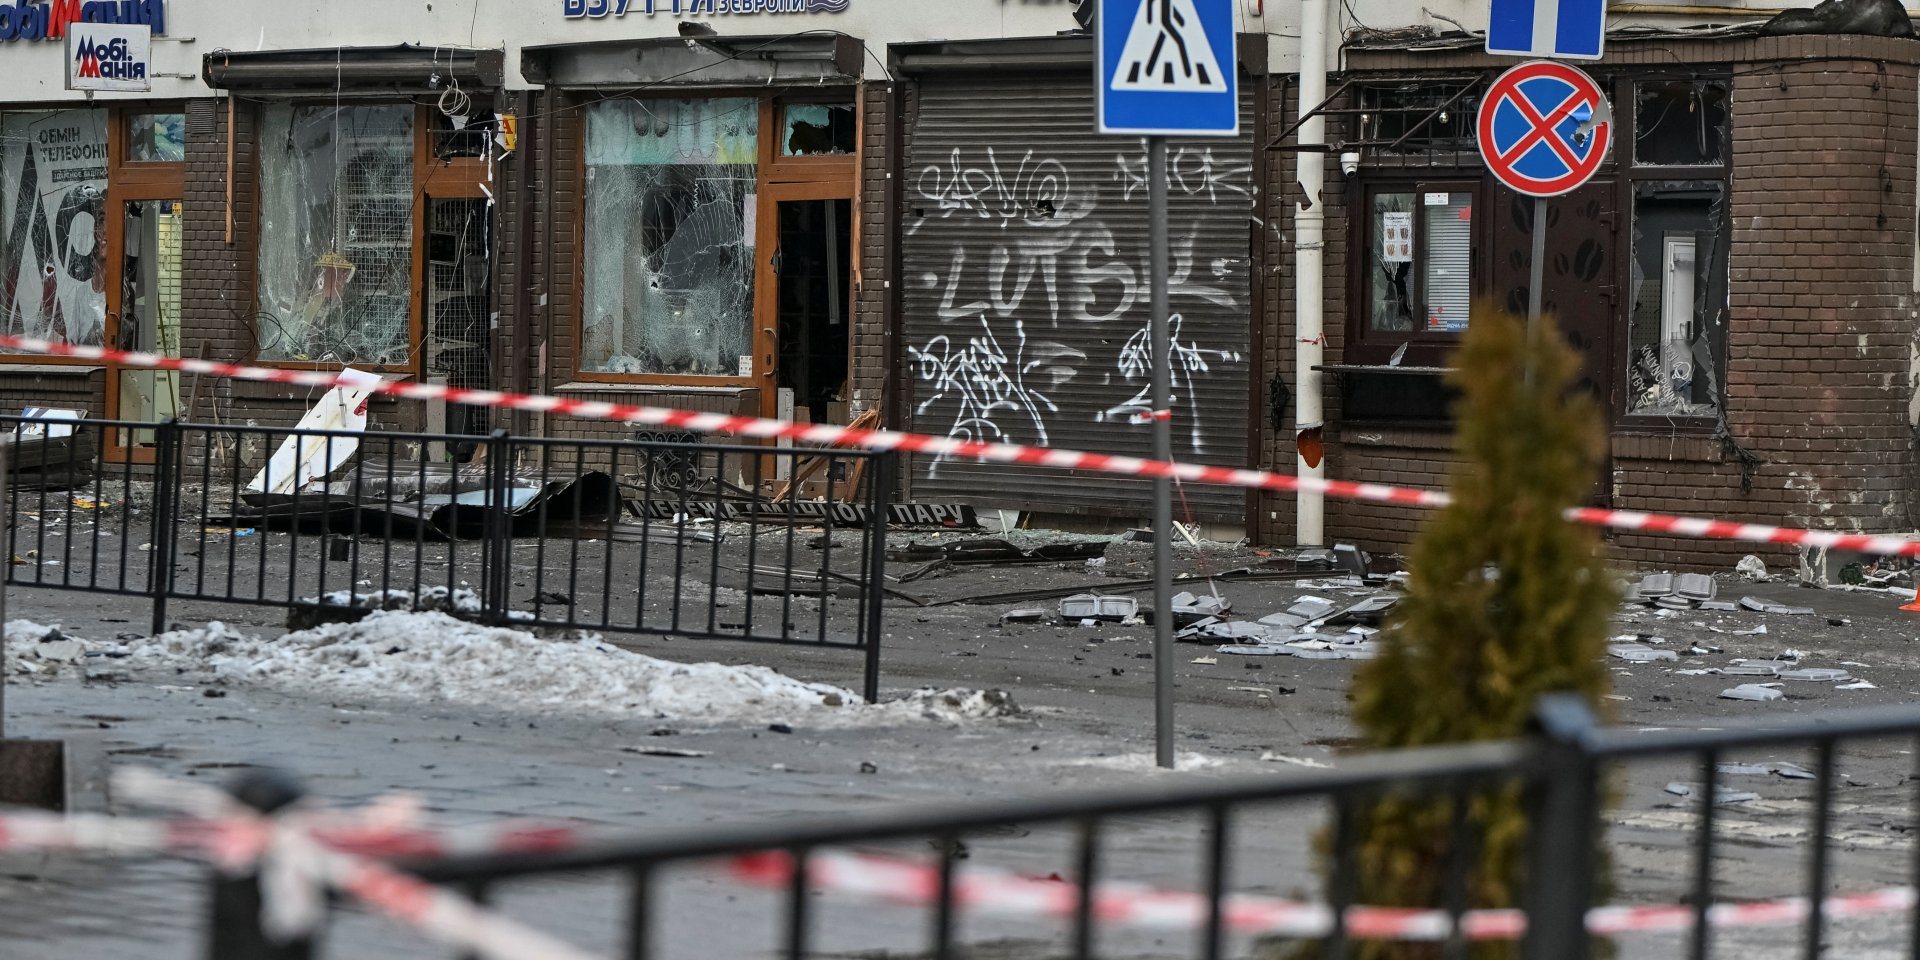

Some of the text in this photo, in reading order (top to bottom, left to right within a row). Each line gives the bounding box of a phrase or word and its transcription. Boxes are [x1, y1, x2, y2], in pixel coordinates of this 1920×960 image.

[79, 55, 146, 79] Манія
[40, 127, 80, 144] ОБМІН
[893, 504, 964, 524] ПАРУ
